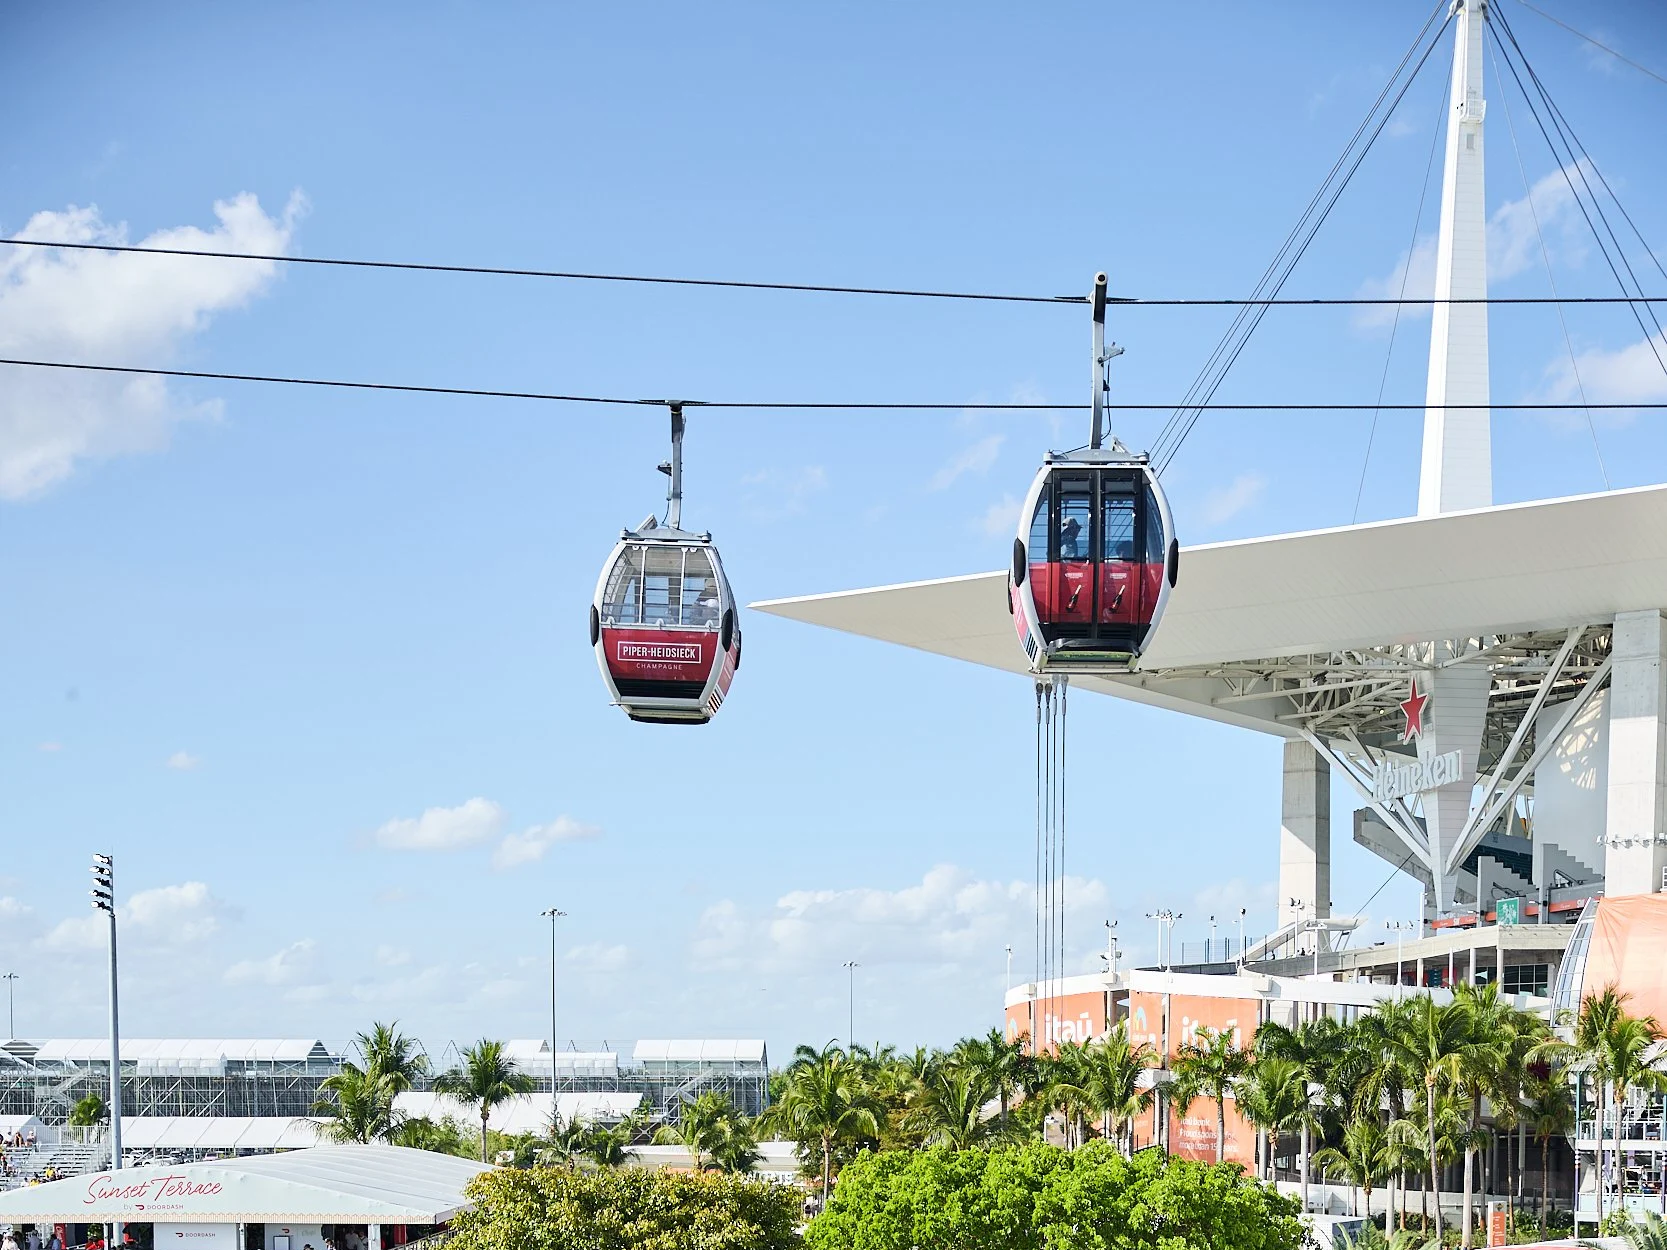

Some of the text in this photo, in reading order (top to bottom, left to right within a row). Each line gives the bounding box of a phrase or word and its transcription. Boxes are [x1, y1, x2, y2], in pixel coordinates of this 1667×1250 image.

[622, 645, 696, 659] PIPER-HEIDSIECK
[636, 663, 683, 671] CHAMPAGNE
[1372, 750, 1463, 803] Heineken
[1045, 1011, 1093, 1044] itaú
[83, 1174, 223, 1204] Sunset Terrace
[123, 1203, 133, 1211] by
